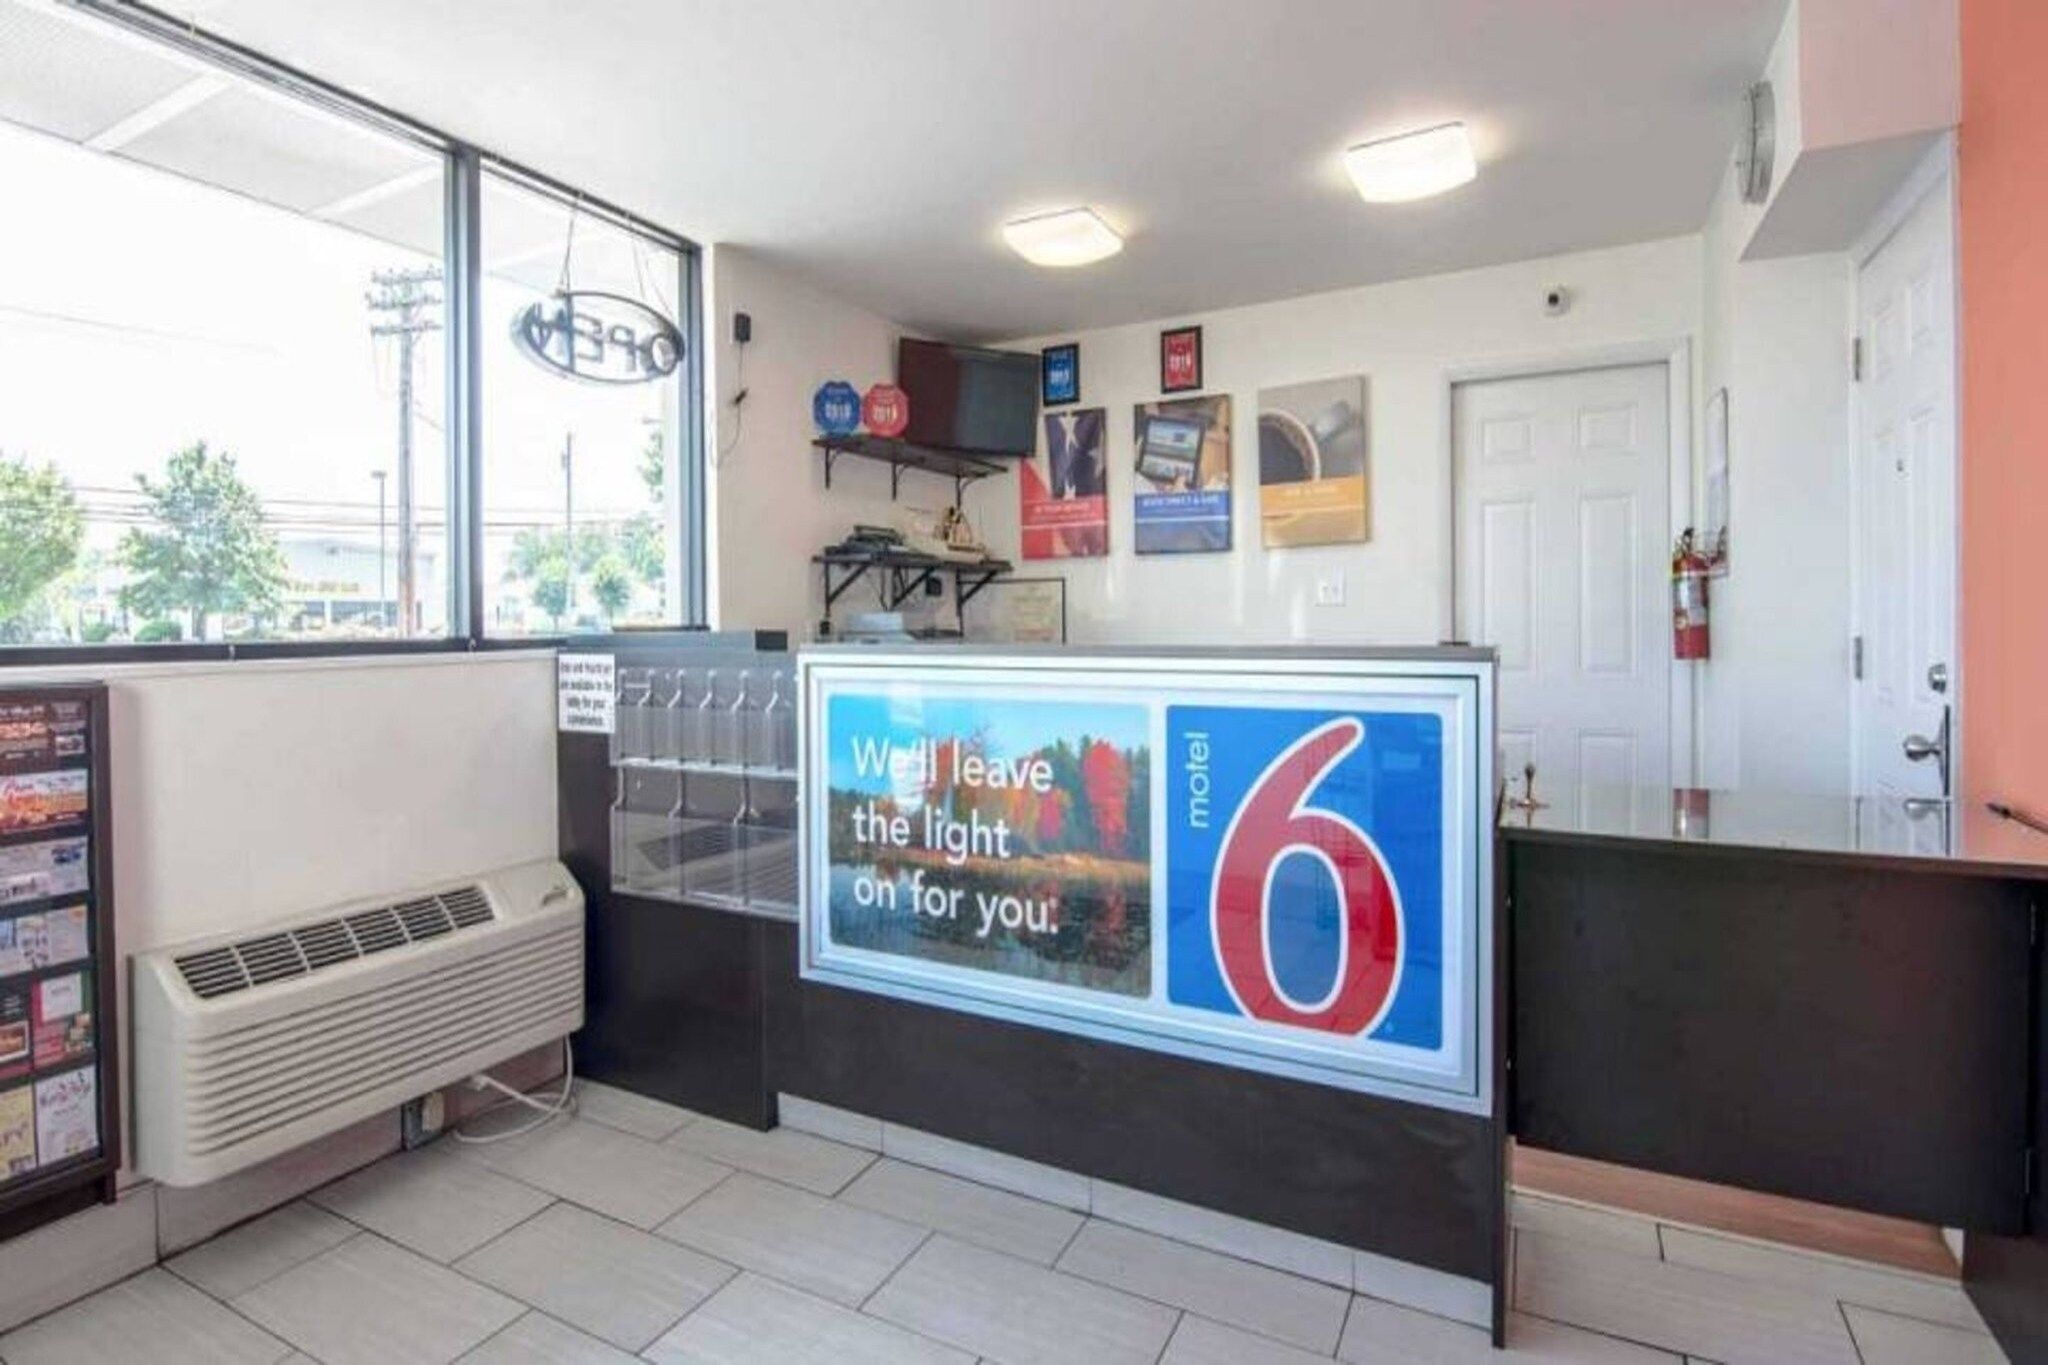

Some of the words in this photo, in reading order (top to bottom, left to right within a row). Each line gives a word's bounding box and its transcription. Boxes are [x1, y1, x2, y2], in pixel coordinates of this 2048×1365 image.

[952, 737, 1054, 793] leave
[1183, 732, 1210, 829] motel
[852, 800, 911, 846] the
[924, 804, 1011, 866] light
[854, 875, 896, 911] on
[912, 869, 965, 920] for
[1209, 716, 1406, 1037] 6
